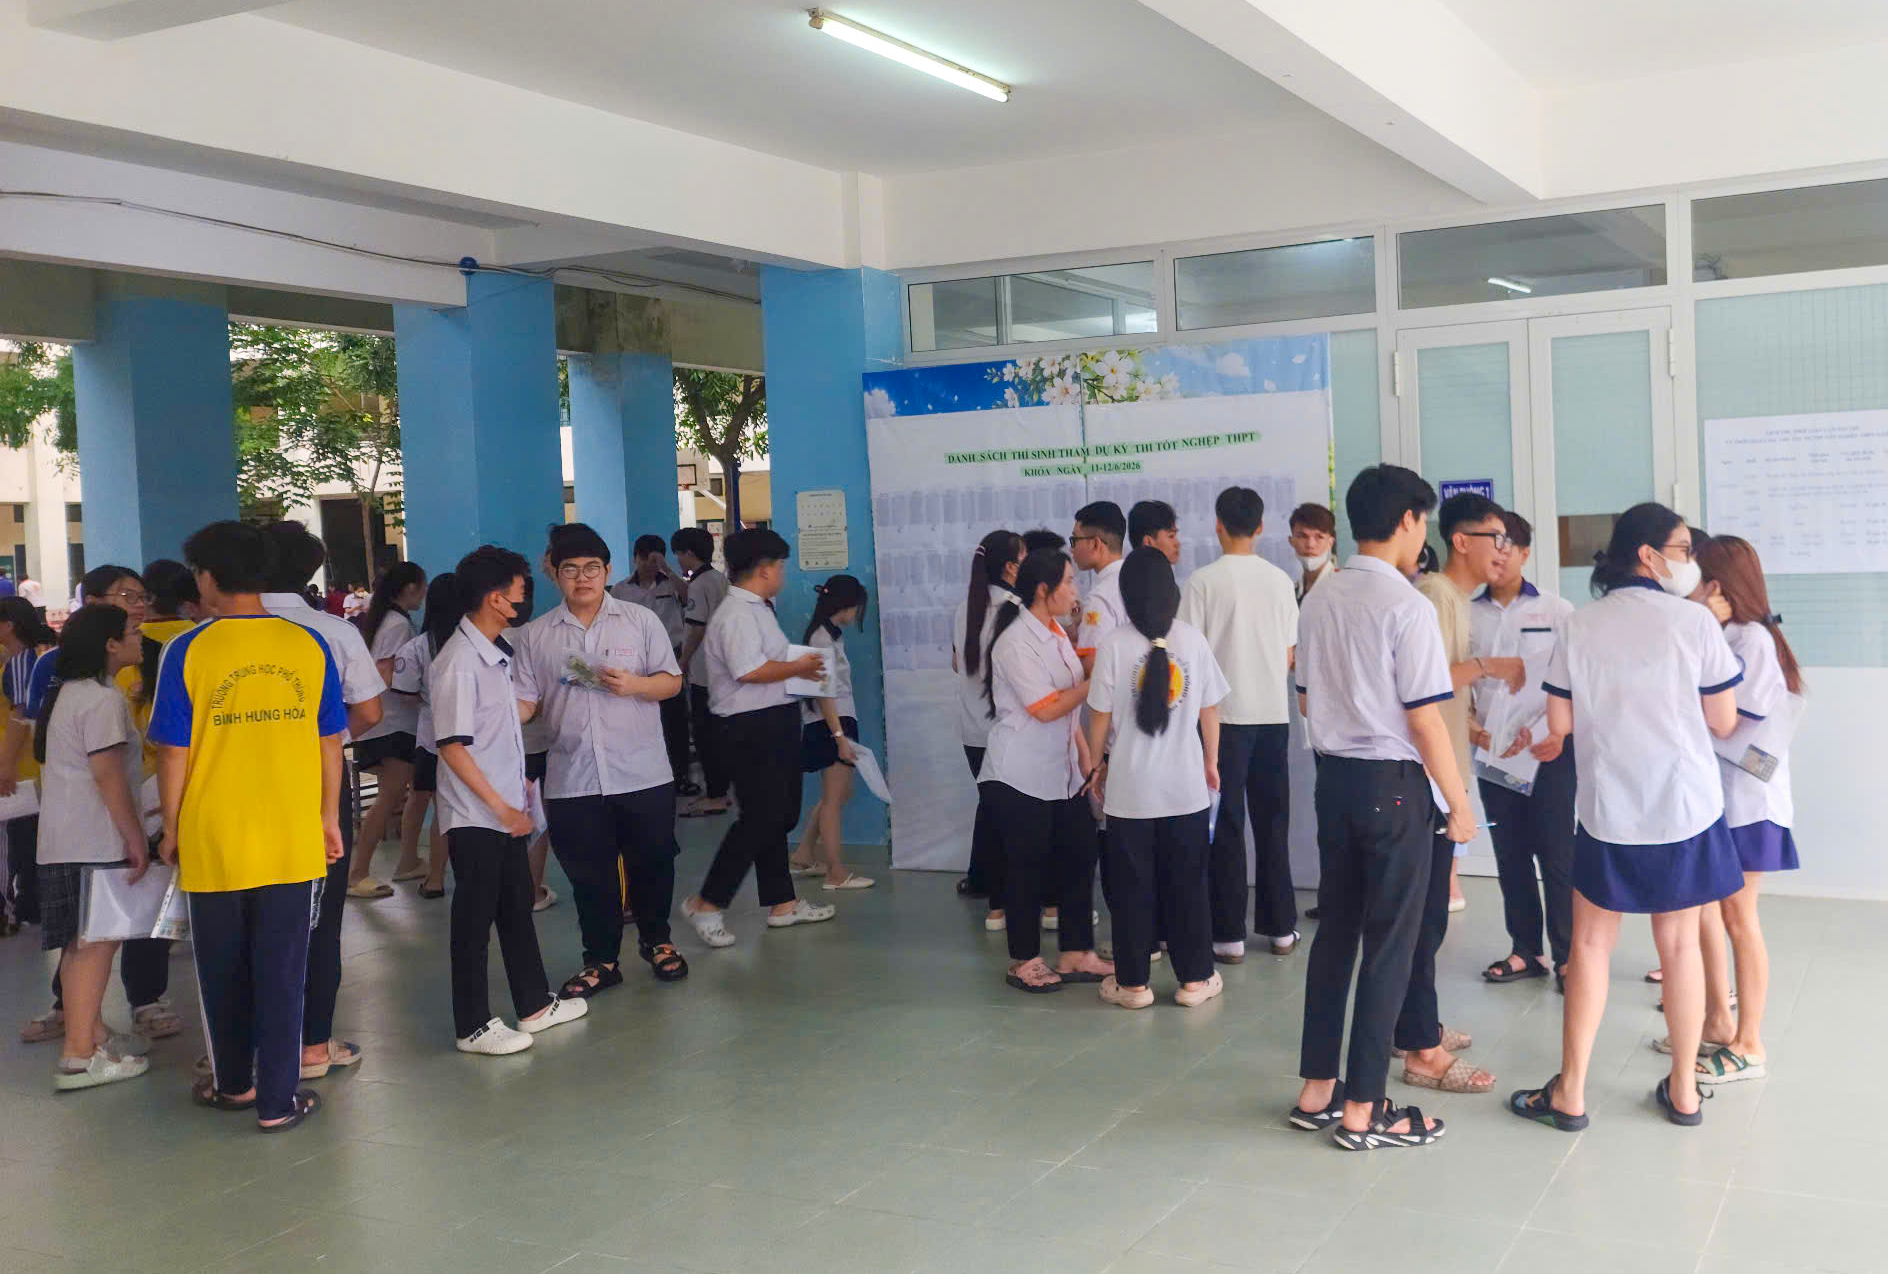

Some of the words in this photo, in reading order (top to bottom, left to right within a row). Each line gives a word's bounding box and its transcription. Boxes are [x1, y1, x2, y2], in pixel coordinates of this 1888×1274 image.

[948, 453, 976, 463] DANH
[1032, 448, 1055, 459] SINH
[1058, 446, 1090, 458] THAM
[1135, 443, 1153, 454] THI
[1225, 432, 1256, 444] THPT
